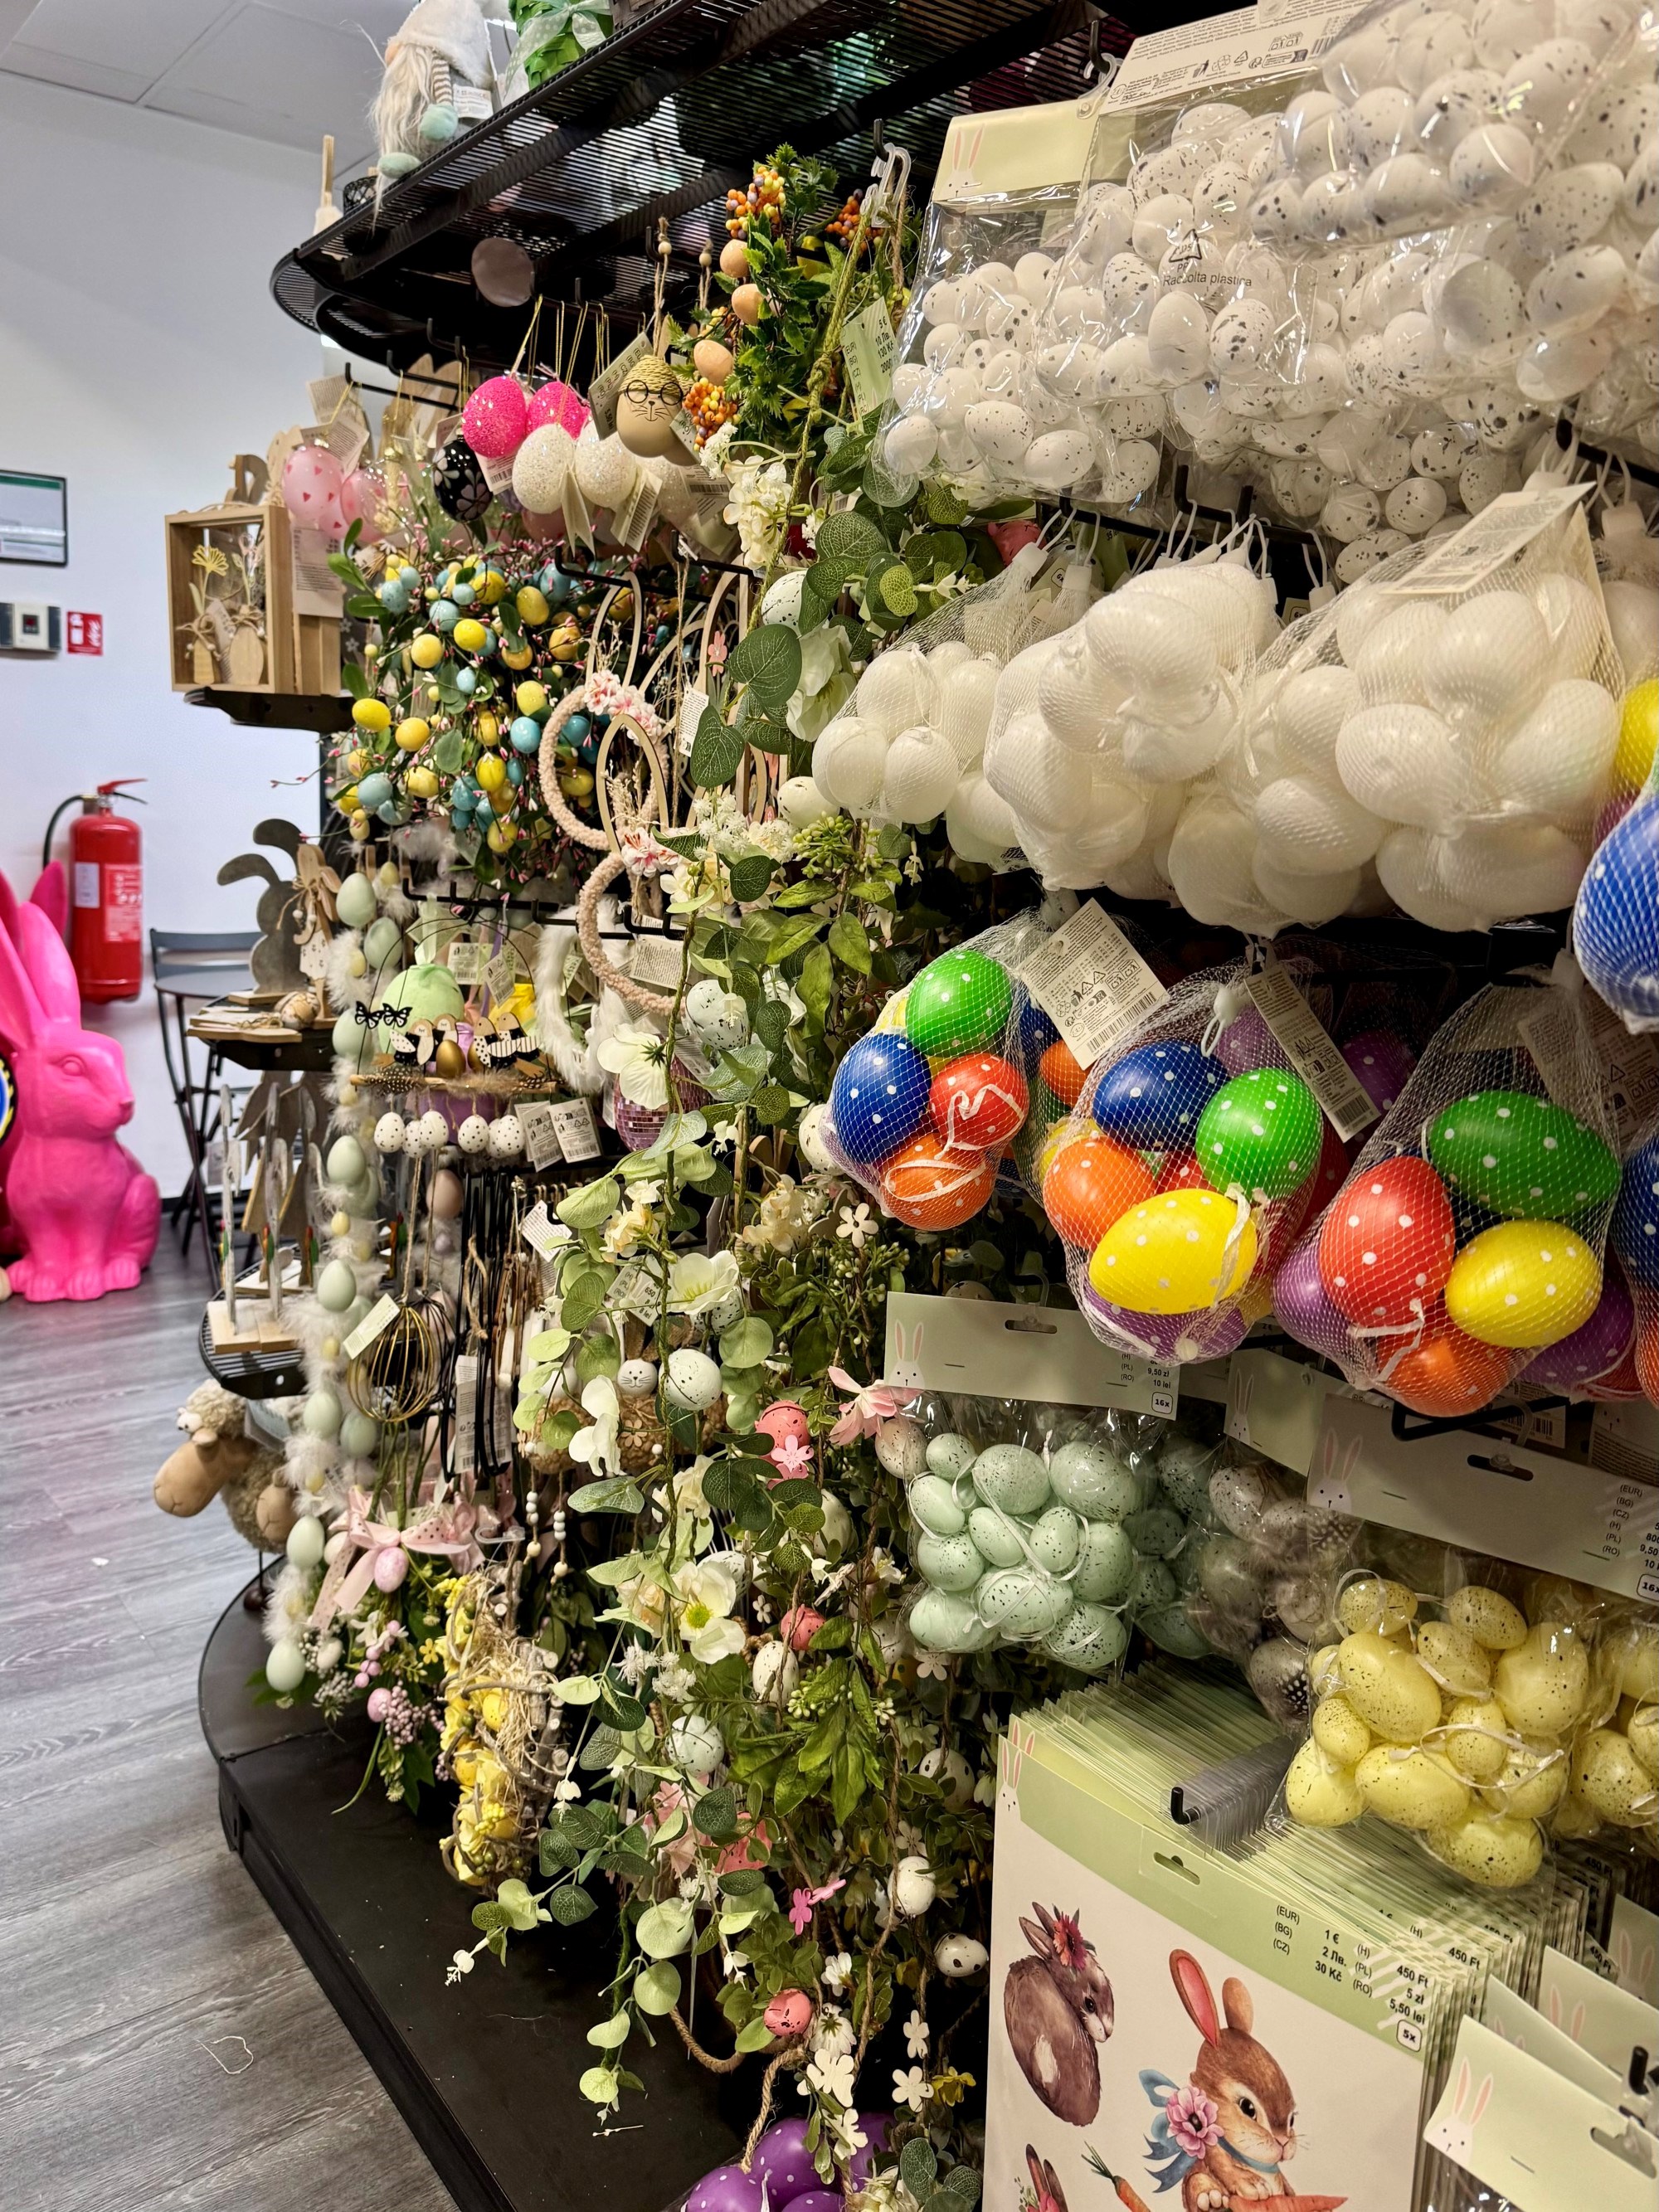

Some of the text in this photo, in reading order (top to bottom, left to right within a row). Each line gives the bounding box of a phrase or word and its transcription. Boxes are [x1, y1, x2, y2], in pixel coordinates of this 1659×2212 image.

[883, 316, 887, 326] €
[645, 1287, 656, 1297] 650
[1121, 1374, 1134, 1382] (RO)
[1148, 1368, 1162, 1376] 9,50
[1155, 1399, 1169, 1407] 16x
[1620, 1484, 1643, 1497] (EUR)
[1617, 1496, 1634, 1508] (BG)
[1613, 1509, 1629, 1521] (CZ)
[1609, 1521, 1621, 1531] (H)
[1606, 1533, 1621, 1545] (PL)
[1602, 1545, 1620, 1557] (RO)
[1276, 1904, 1340, 1945] (EUR) 1 €
[1274, 1921, 1293, 1939] (BG)
[1322, 1946, 1328, 1957] 2
[1410, 1924, 1481, 1970] (H) 450 Ft
[1273, 1937, 1342, 1983] (CZ) 30 Kč
[1357, 1943, 1429, 1988] (H) 450 Ft
[1355, 1961, 1372, 1978] (PL)
[1407, 1988, 1413, 1999] 5
[1353, 1979, 1426, 2024] (RO) 5,50 lei
[1403, 2029, 1417, 2043] 5x
